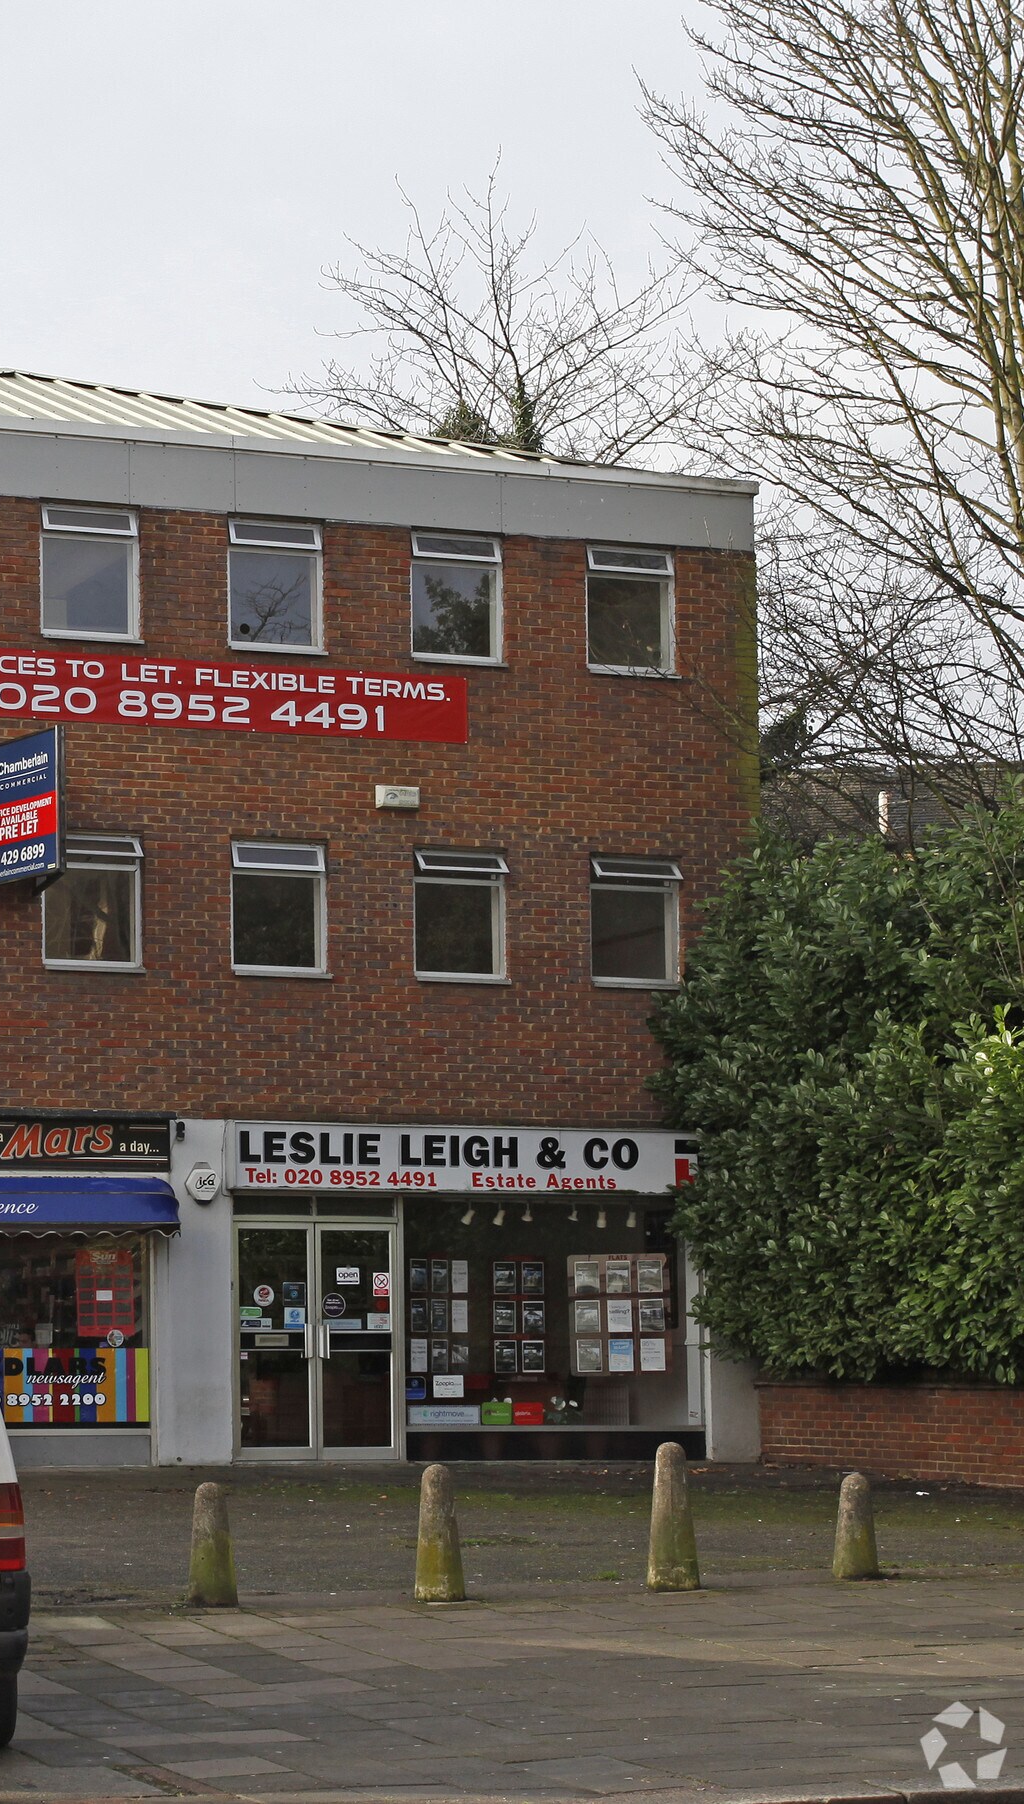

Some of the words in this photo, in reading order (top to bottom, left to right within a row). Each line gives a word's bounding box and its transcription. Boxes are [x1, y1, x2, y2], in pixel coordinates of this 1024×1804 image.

[66, 660, 104, 679] TO
[121, 663, 182, 684] LET.
[195, 668, 335, 694] FLEXIBLE
[346, 676, 450, 701] TERMS.
[118, 689, 250, 724] 8952
[271, 701, 384, 731] 4491
[0, 773, 47, 791] COMMERCIAL
[11, 797, 52, 814] DEVELOPMENT
[1, 810, 38, 827] AVAILABLE
[0, 824, 19, 841] PRE
[21, 819, 39, 837] LET
[1, 849, 19, 867] 429
[20, 843, 45, 862] 6899
[0, 1123, 113, 1160] Mars
[119, 1142, 126, 1152] a
[130, 1141, 159, 1155] day...
[240, 1130, 382, 1165] LESLIE
[400, 1133, 519, 1168] LEIGH
[537, 1136, 566, 1170] &
[583, 1137, 640, 1170] CO
[246, 1168, 277, 1184] Tel:
[284, 1169, 323, 1186] 020
[329, 1170, 380, 1187] 8952
[386, 1172, 437, 1188] 4491
[472, 1172, 537, 1189] Estate
[546, 1173, 617, 1191] Agents
[91, 1251, 116, 1260] Sun
[338, 1270, 359, 1280] open
[27, 1371, 106, 1389] newsagent
[6, 1393, 53, 1406] 8952
[60, 1393, 106, 1406] 2200
